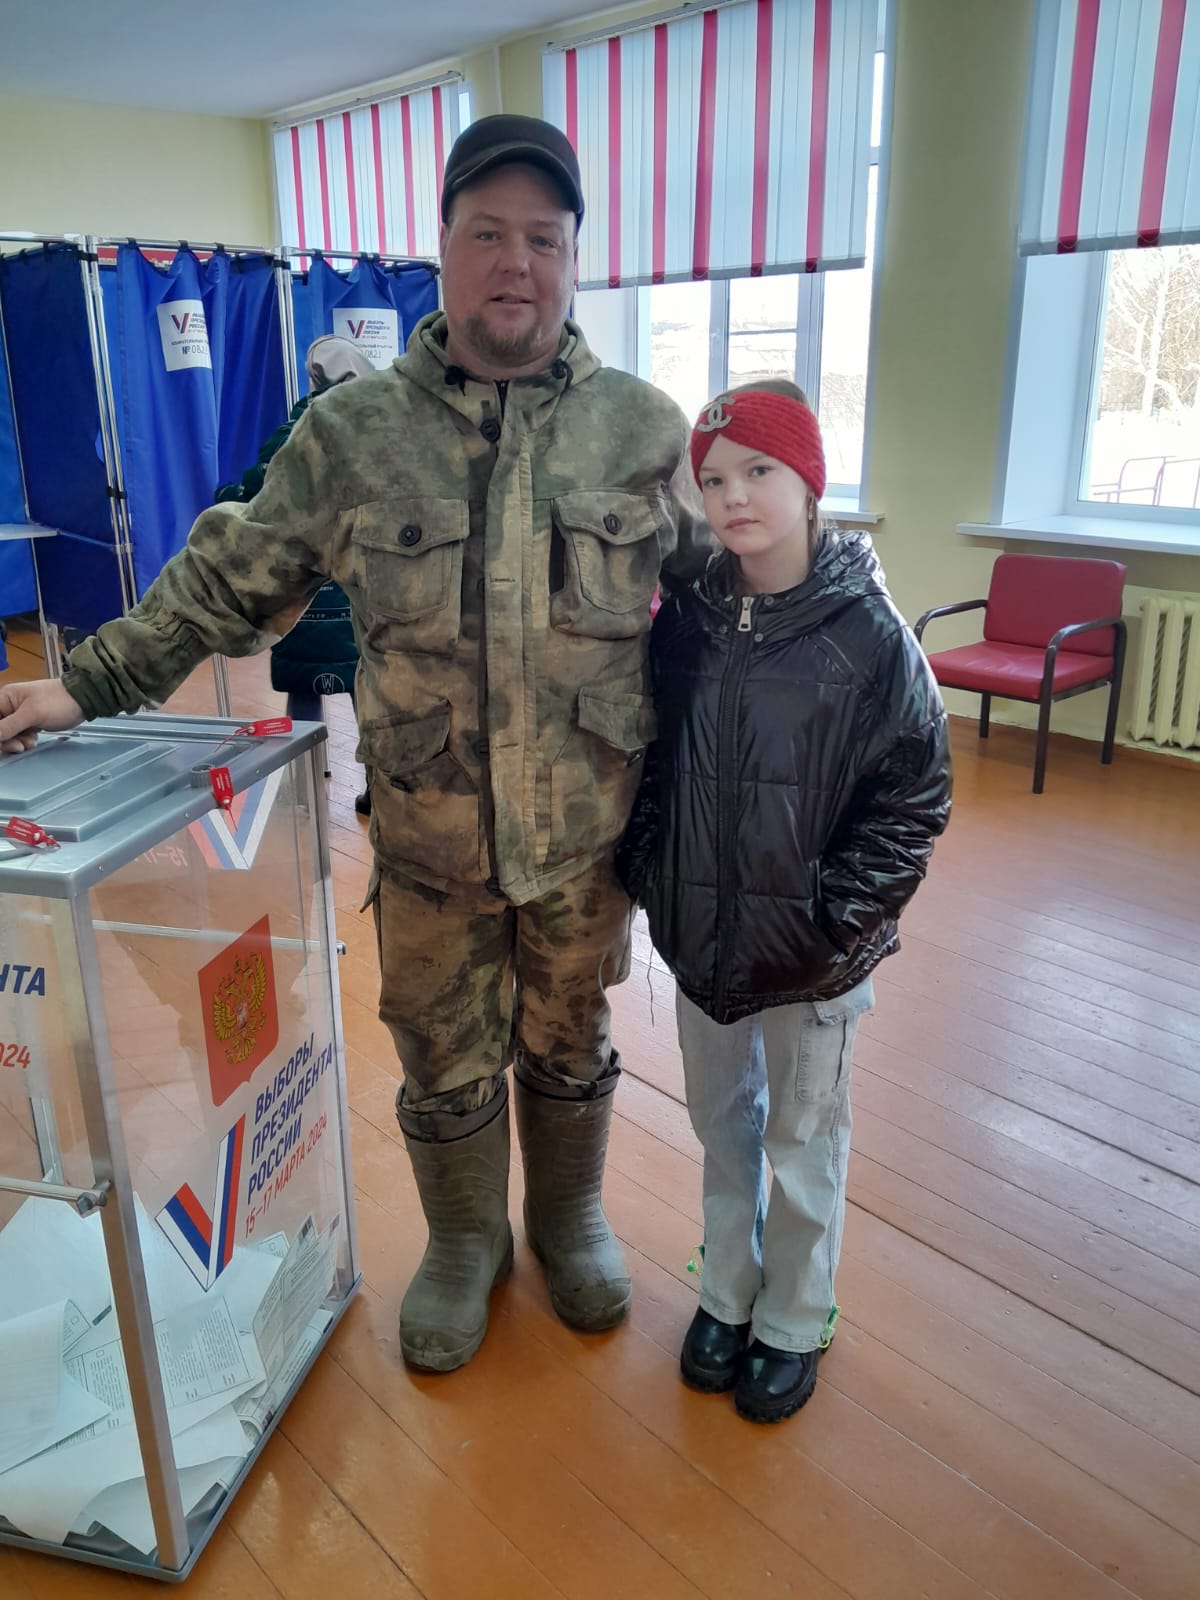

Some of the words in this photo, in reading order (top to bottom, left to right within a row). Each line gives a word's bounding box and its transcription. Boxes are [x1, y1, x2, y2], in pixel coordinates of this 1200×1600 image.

[250, 1042, 333, 1166] ПРЕЗИДЕНТА
[254, 1031, 315, 1126] ВЫБОРЫ
[247, 1112, 303, 1206] РОССИИ
[274, 1141, 306, 1202] МАРТА
[306, 1111, 329, 1154] 2024
